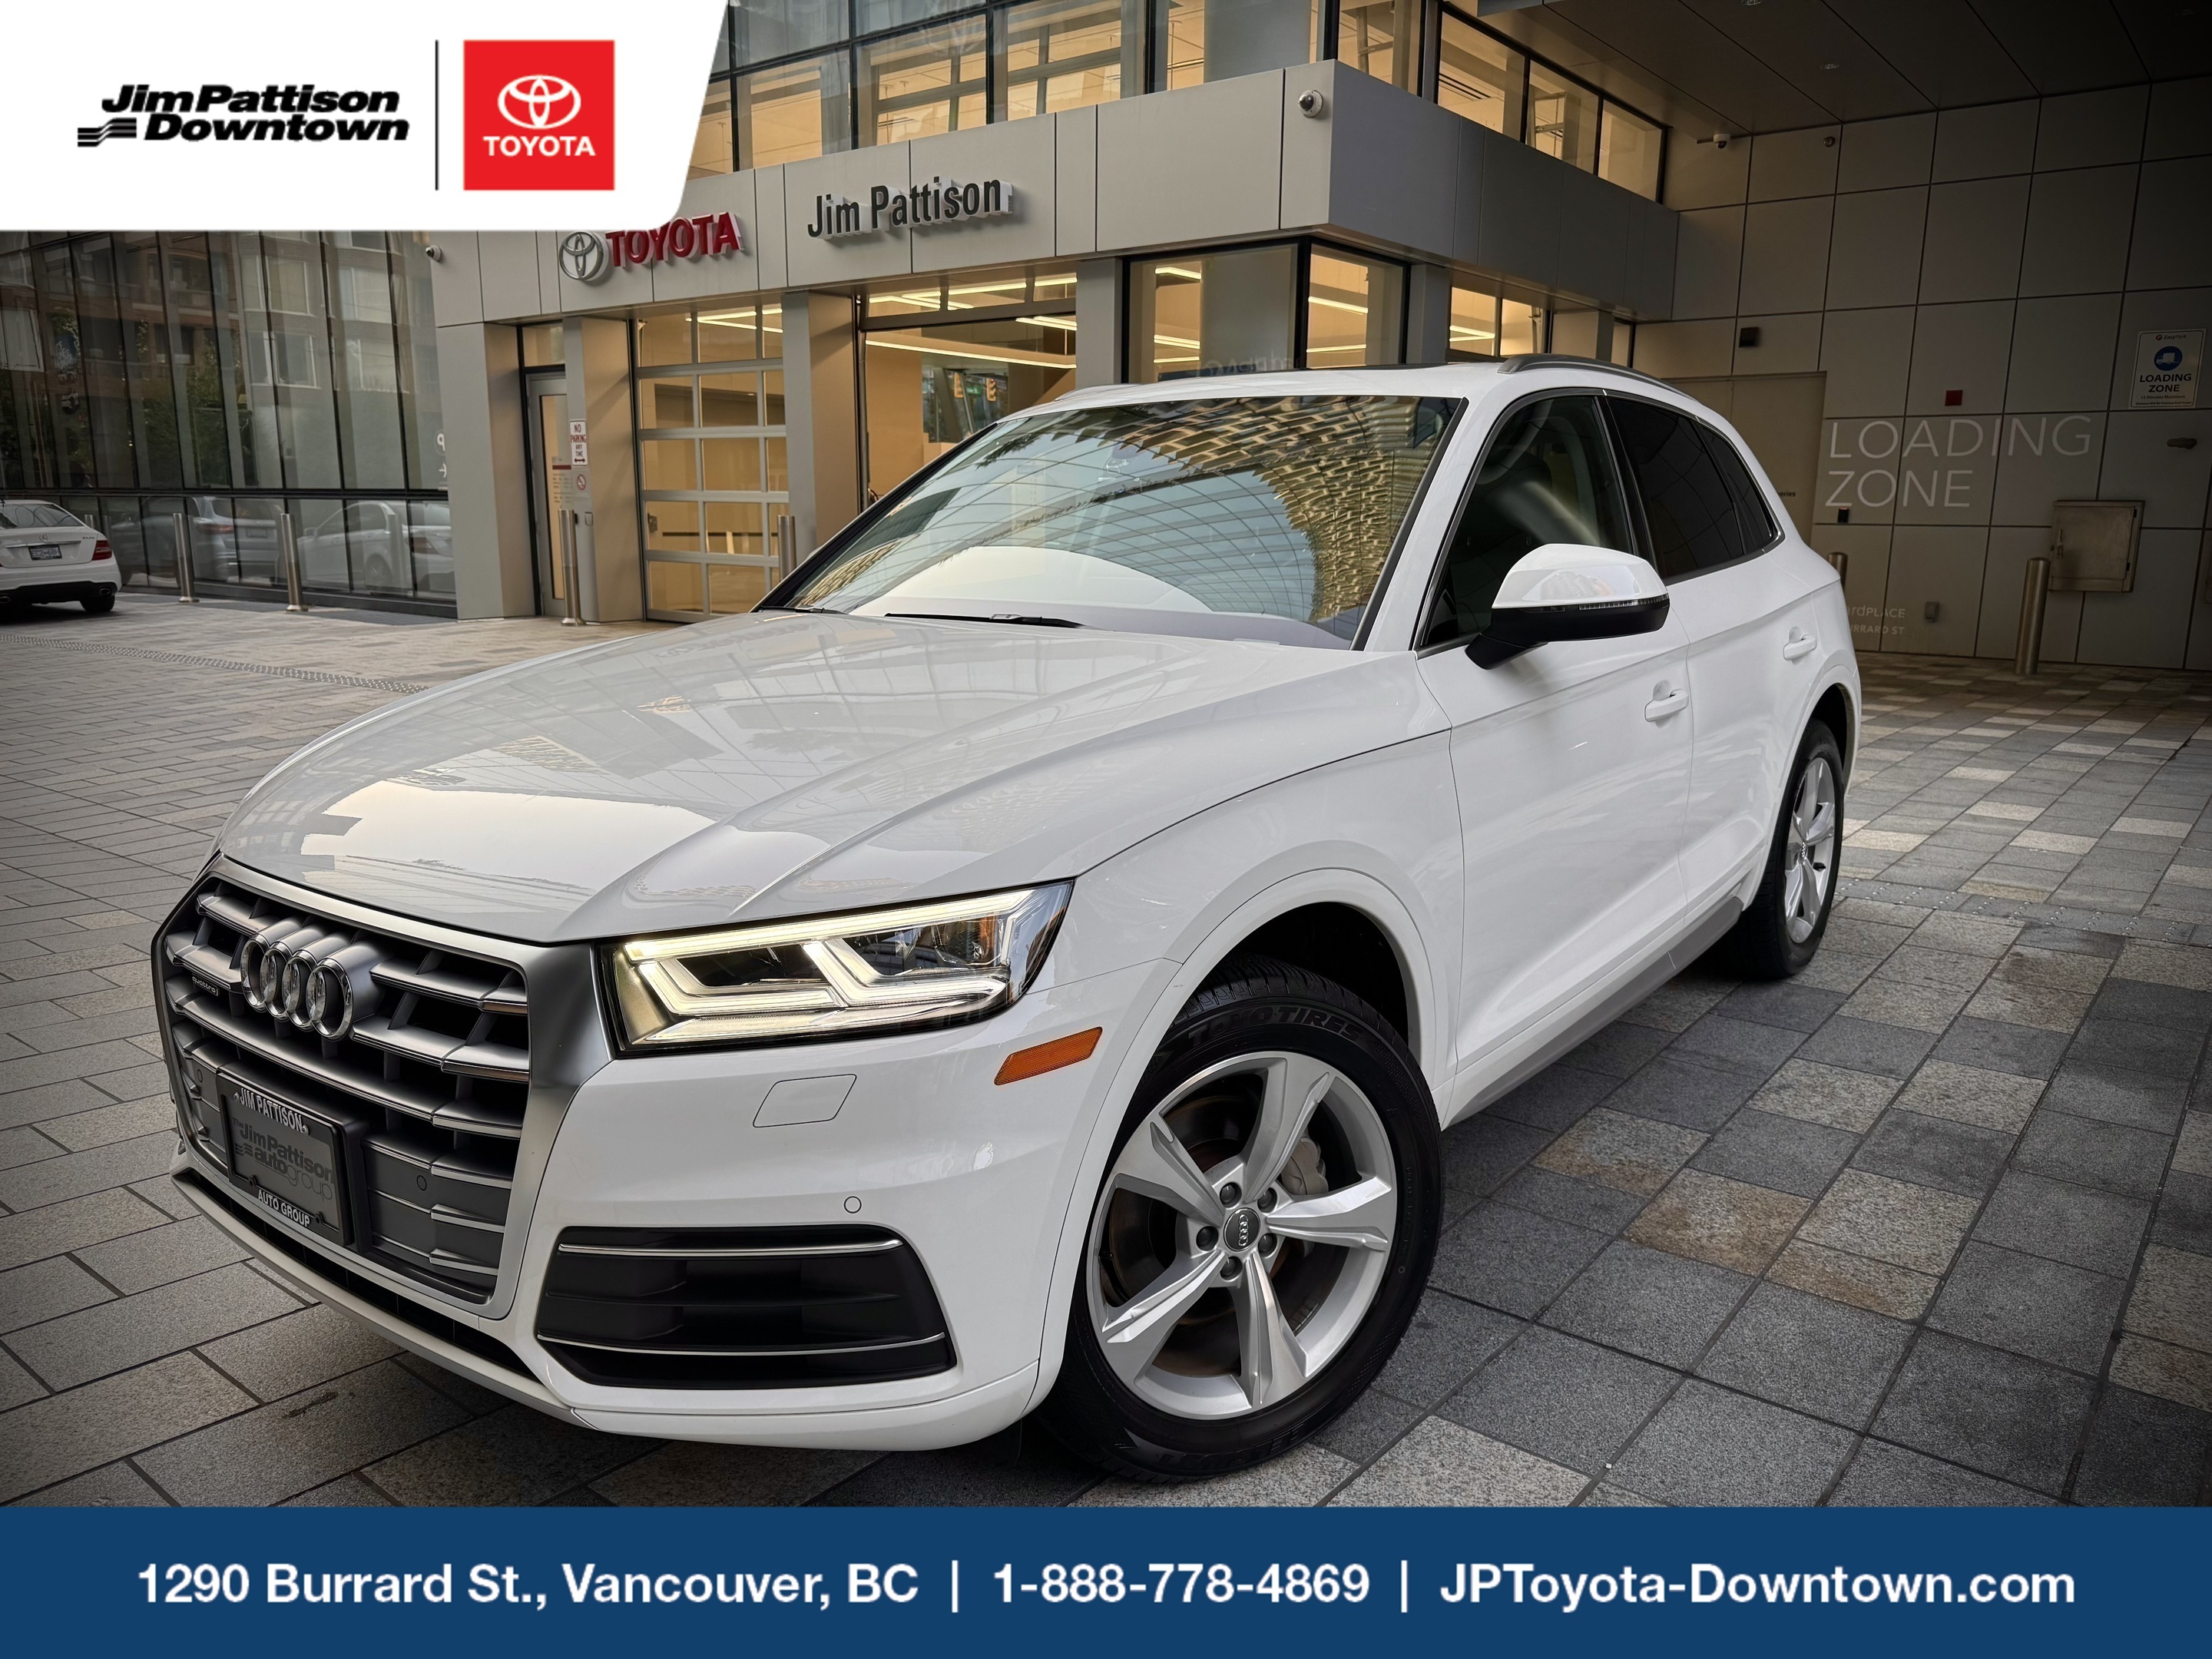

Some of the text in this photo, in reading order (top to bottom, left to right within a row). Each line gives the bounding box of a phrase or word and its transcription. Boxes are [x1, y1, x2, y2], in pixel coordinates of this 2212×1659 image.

[806, 176, 1002, 238] Jim Pattison
[604, 211, 740, 267] TOYOTA
[2140, 373, 2192, 382] LOADING
[2148, 384, 2180, 392] ZONE
[570, 434, 587, 443] PARKING
[575, 424, 581, 433] NO
[1828, 415, 2094, 459] LOADING
[1825, 468, 1974, 508] ZONE
[1891, 625, 1906, 635] ST
[191, 975, 217, 994] quattro
[1187, 1005, 1366, 1048] TOYO TIRES
[232, 1117, 245, 1130] The
[240, 1088, 304, 1133] JIM PATTISON
[257, 1189, 311, 1227] AUTO GROUP
